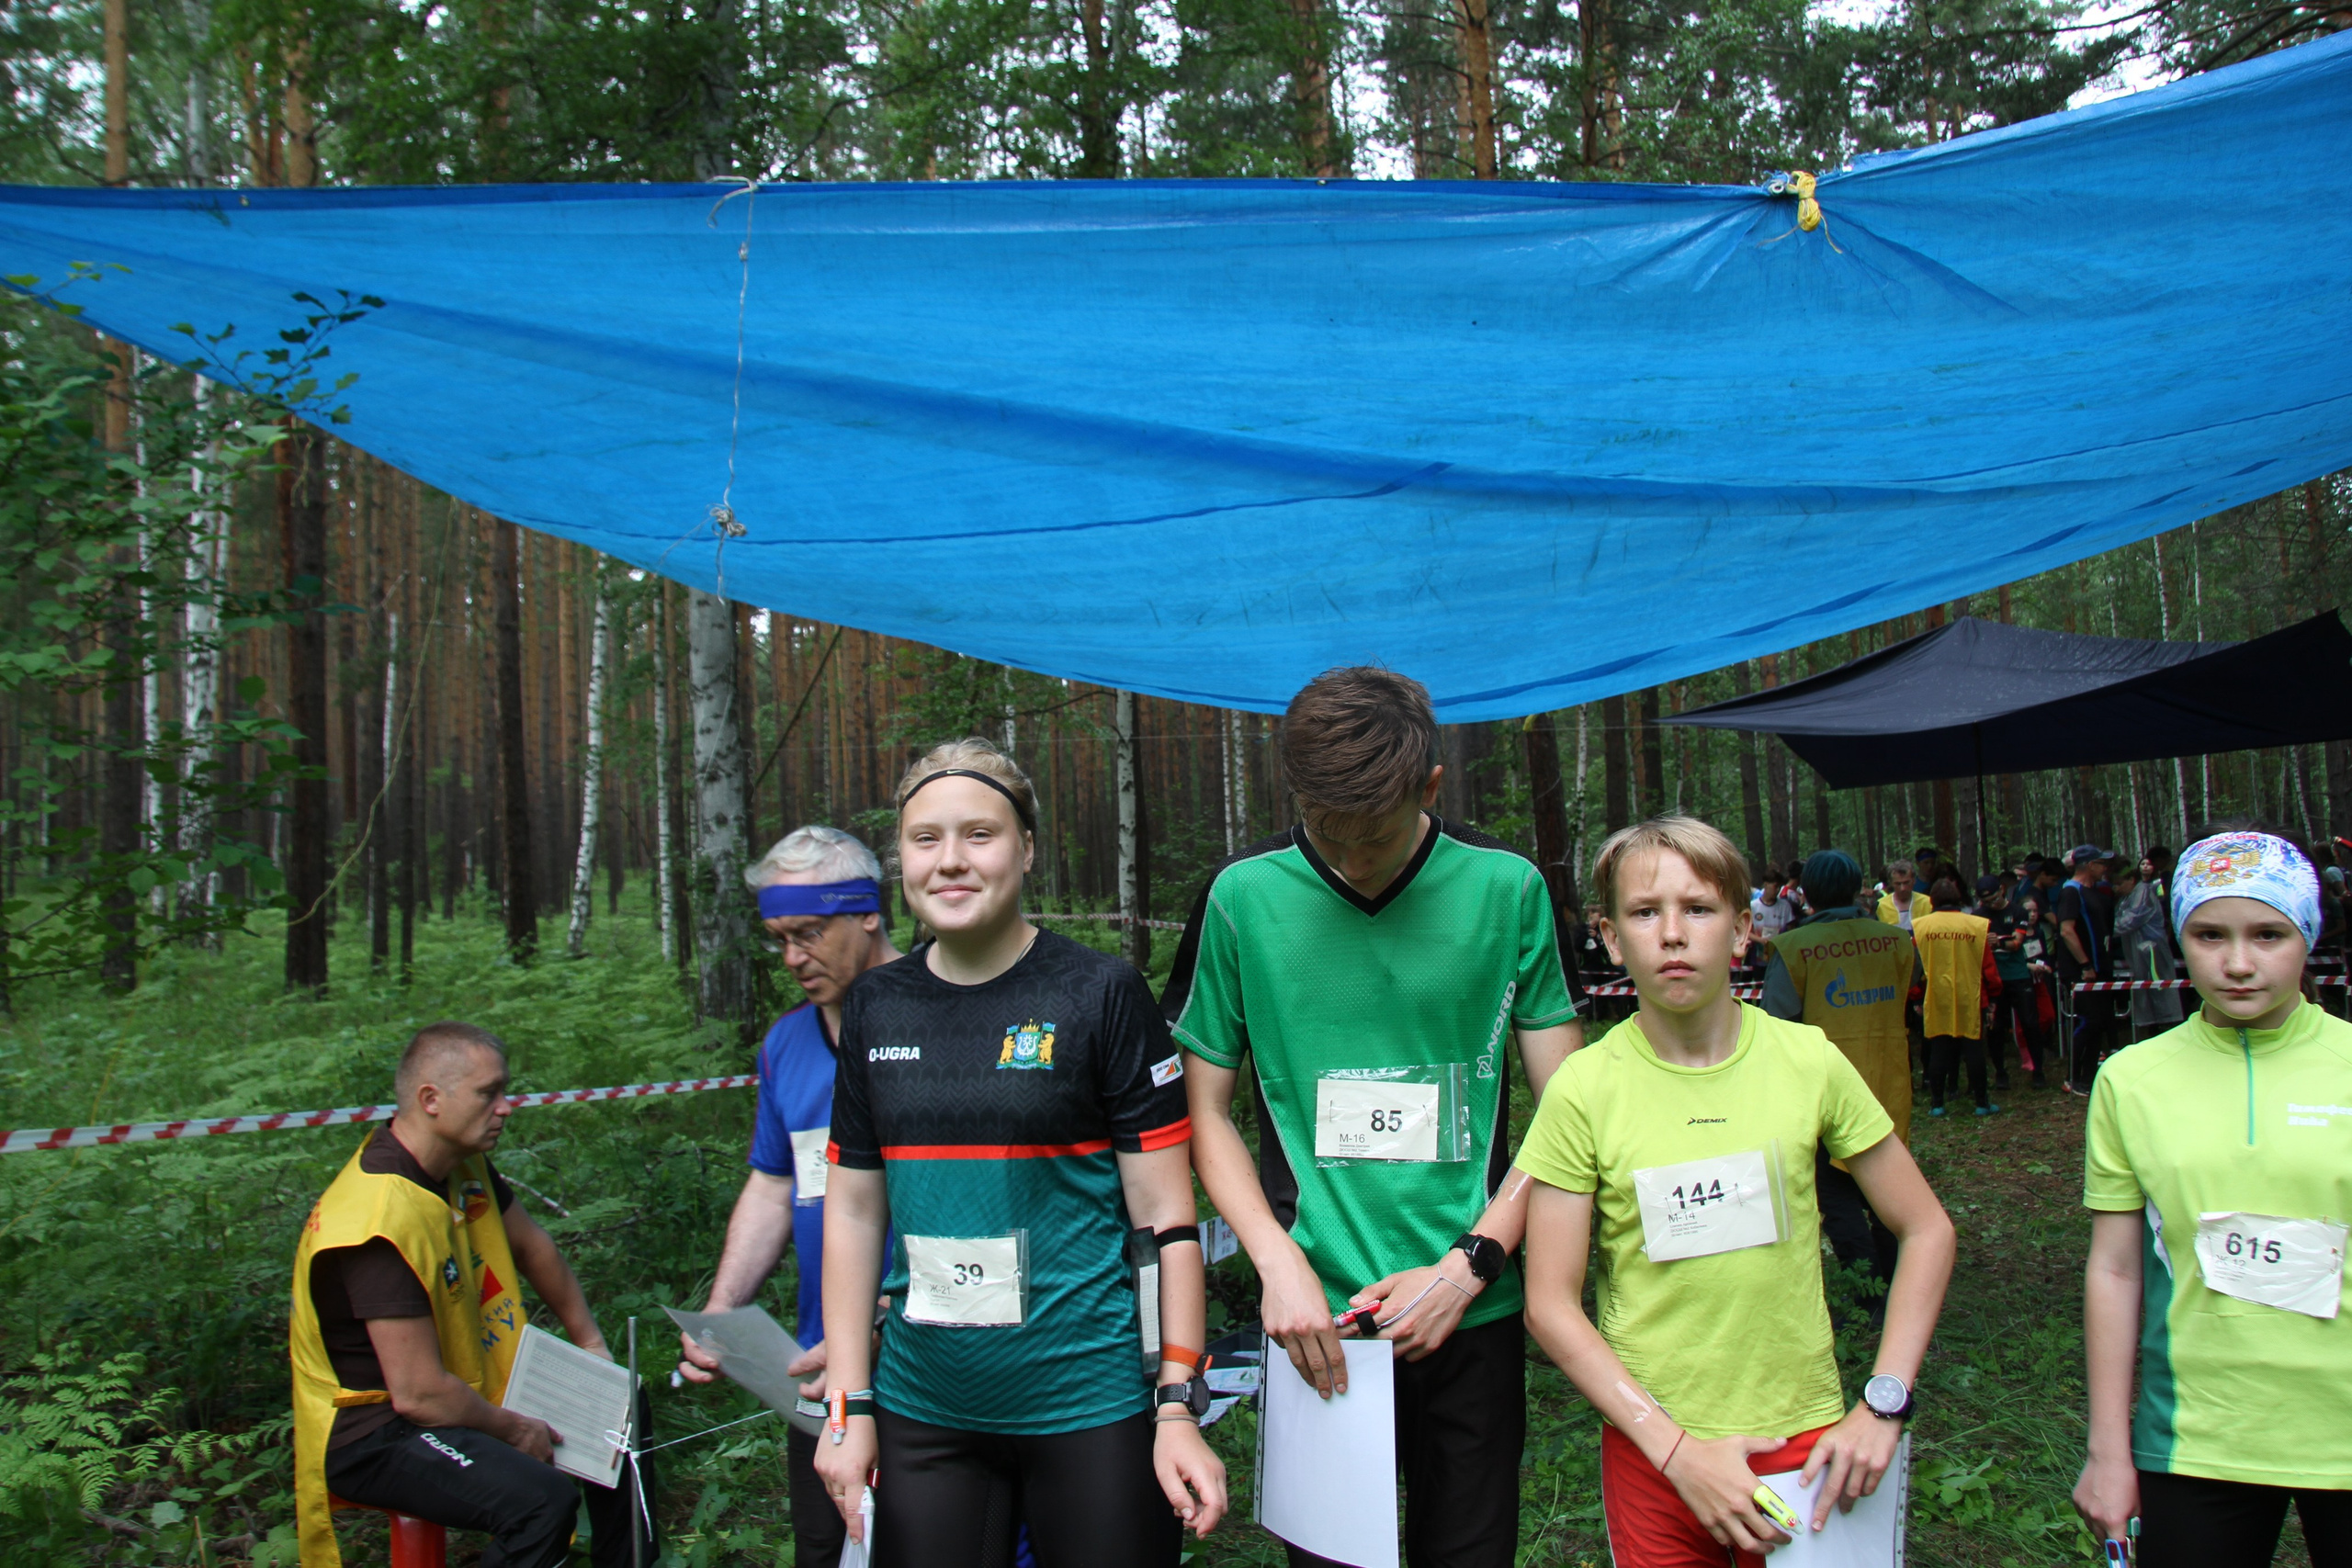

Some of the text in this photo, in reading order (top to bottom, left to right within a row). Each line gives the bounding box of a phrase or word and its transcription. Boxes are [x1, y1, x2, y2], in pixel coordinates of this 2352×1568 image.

[1800, 936, 1899, 964] РОССПОРТ
[868, 1046, 921, 1063] O-UGRA
[1370, 1109, 1403, 1133] 85
[1672, 1179, 1724, 1209] 144
[2225, 1232, 2282, 1264] 615
[954, 1263, 984, 1286] 39
[420, 1432, 474, 1467] NORD
